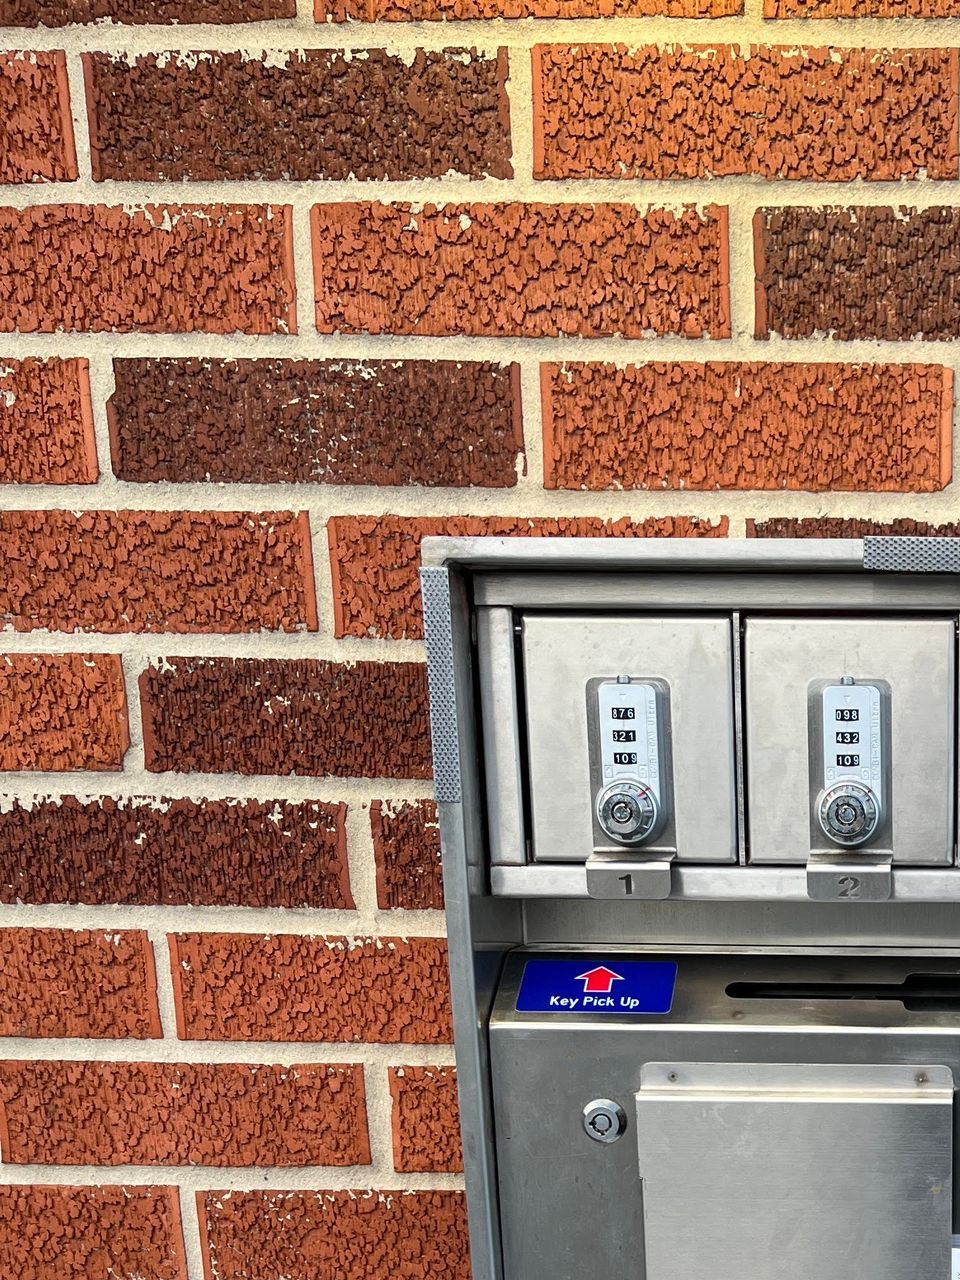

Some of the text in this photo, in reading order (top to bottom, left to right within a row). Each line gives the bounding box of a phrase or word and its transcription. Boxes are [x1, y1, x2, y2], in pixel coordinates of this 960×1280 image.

[612, 709, 634, 718] 876
[836, 710, 858, 720] 098
[613, 731, 634, 741] 321
[836, 733, 859, 743] 432
[616, 754, 637, 763] 109
[838, 756, 859, 765] 109
[618, 874, 633, 896] 1
[837, 876, 861, 898] 2
[550, 996, 640, 1009] Key Pick Up
